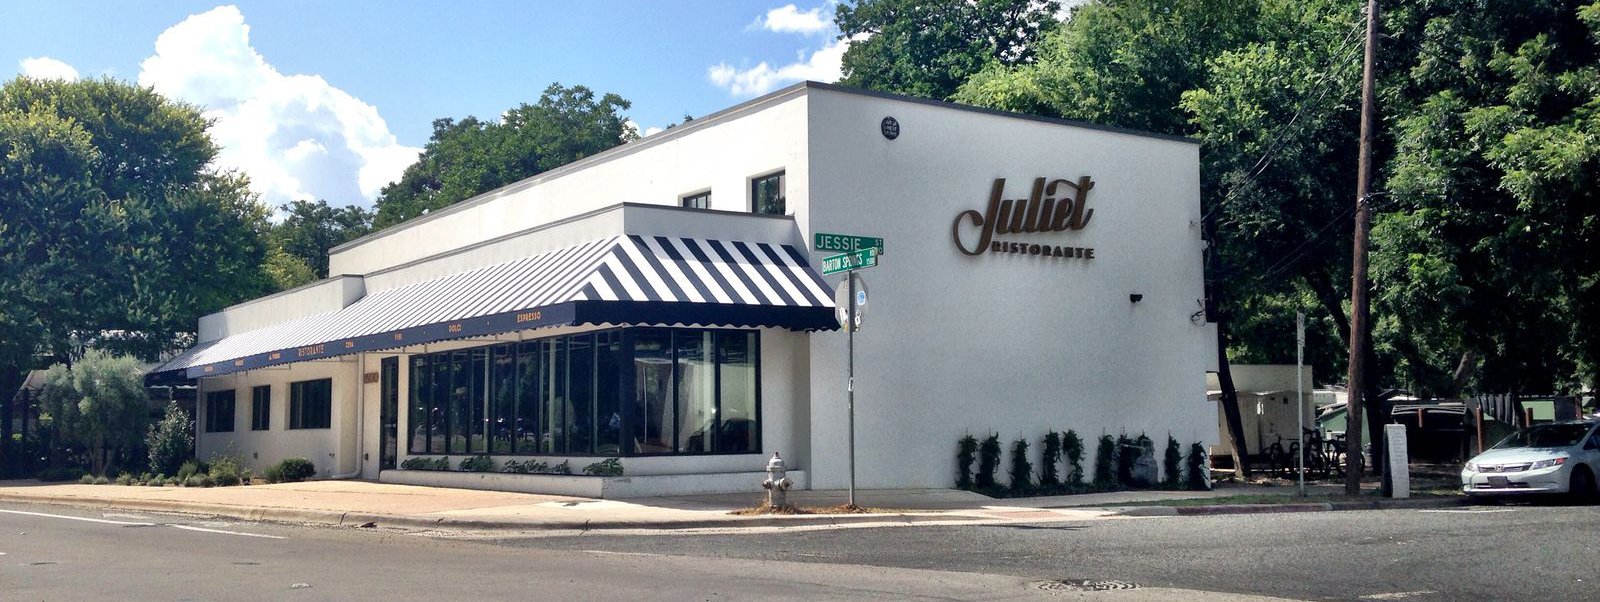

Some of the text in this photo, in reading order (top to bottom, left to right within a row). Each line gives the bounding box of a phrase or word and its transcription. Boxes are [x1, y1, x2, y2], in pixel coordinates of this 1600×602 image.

[952, 175, 1095, 256] Juliet
[816, 236, 860, 250] JESSIE
[991, 240, 1095, 259] RISTORANTE
[517, 311, 541, 322] ESPRESSO
[448, 324, 462, 333] DOLCI
[298, 344, 324, 357] RISTORANTE
